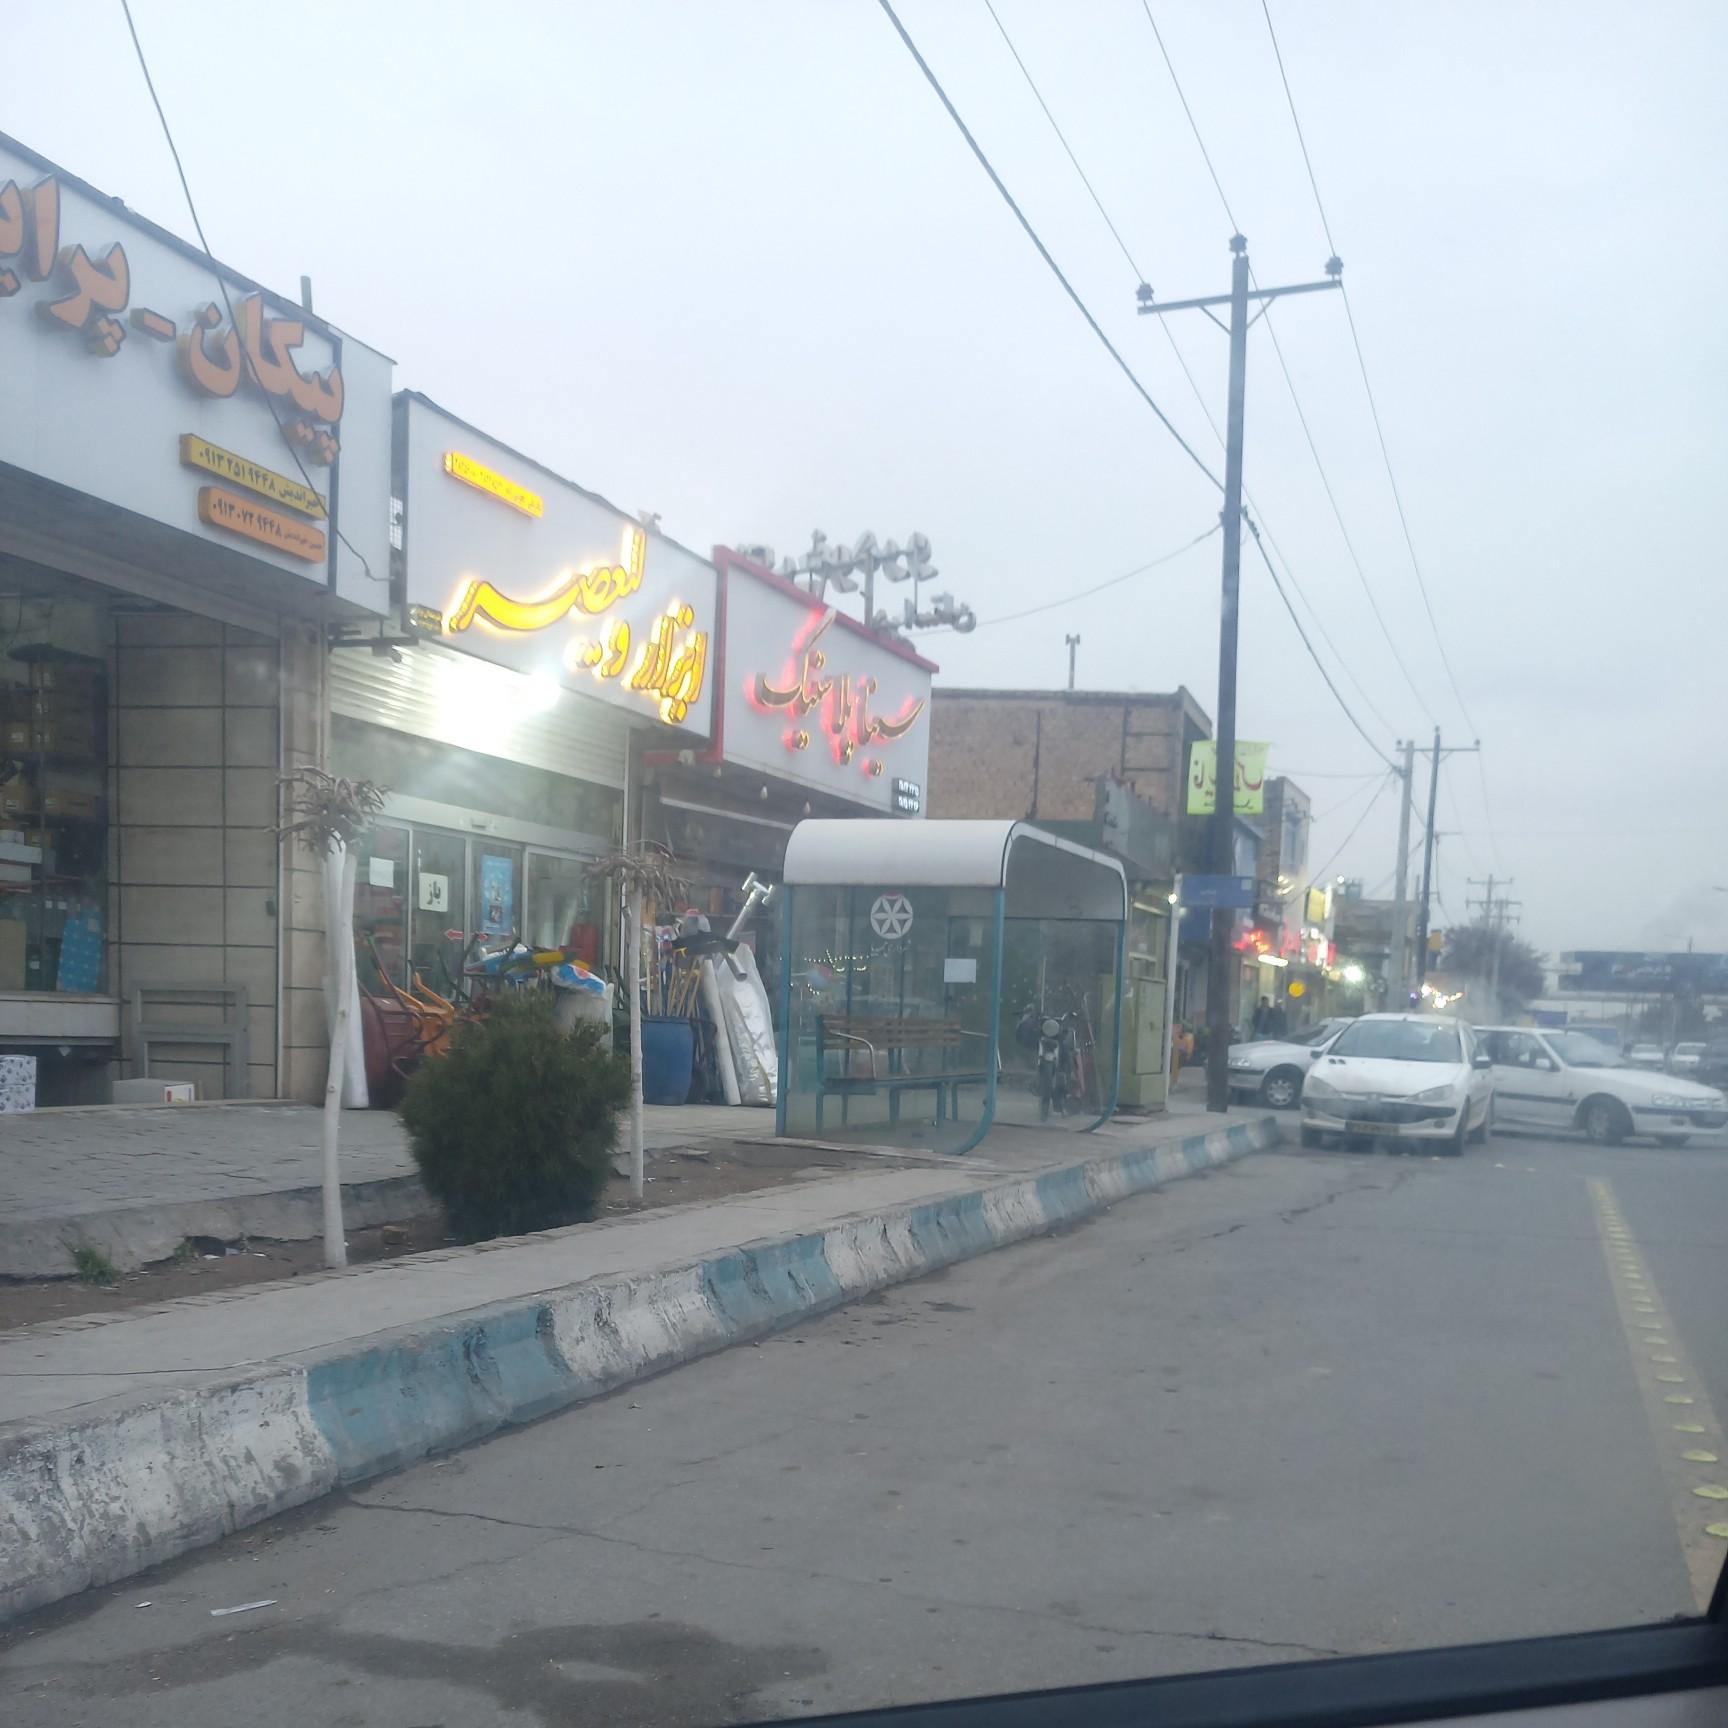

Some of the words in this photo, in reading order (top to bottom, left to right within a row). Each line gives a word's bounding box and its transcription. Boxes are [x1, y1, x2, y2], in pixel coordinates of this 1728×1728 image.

[0, 174, 130, 358] پرای
[180, 292, 344, 466] پیکان
[629, 600, 708, 724] ابزار
[426, 880, 441, 905] باز
